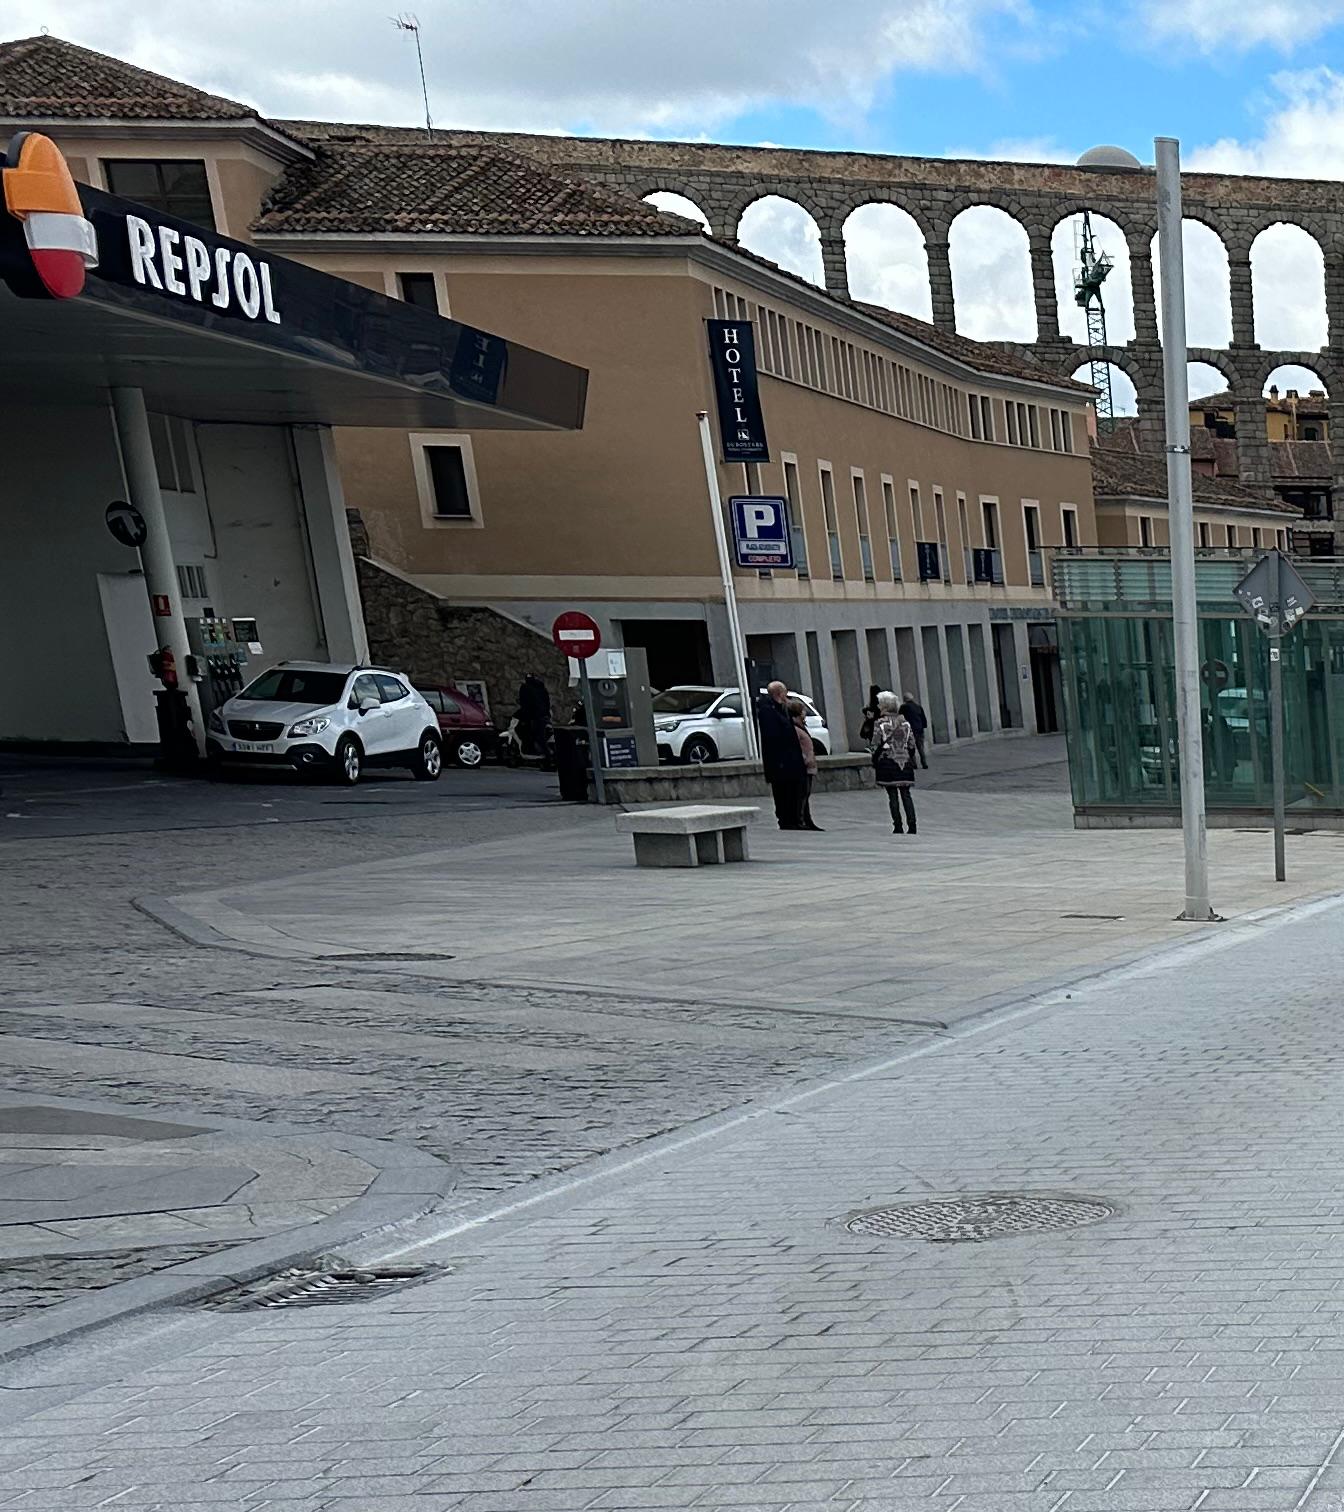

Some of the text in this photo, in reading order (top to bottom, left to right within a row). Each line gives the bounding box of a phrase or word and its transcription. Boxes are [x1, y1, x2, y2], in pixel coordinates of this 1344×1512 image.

[126, 214, 281, 325] REPSOL
[723, 328, 747, 422] HOTEL
[743, 504, 776, 539] P
